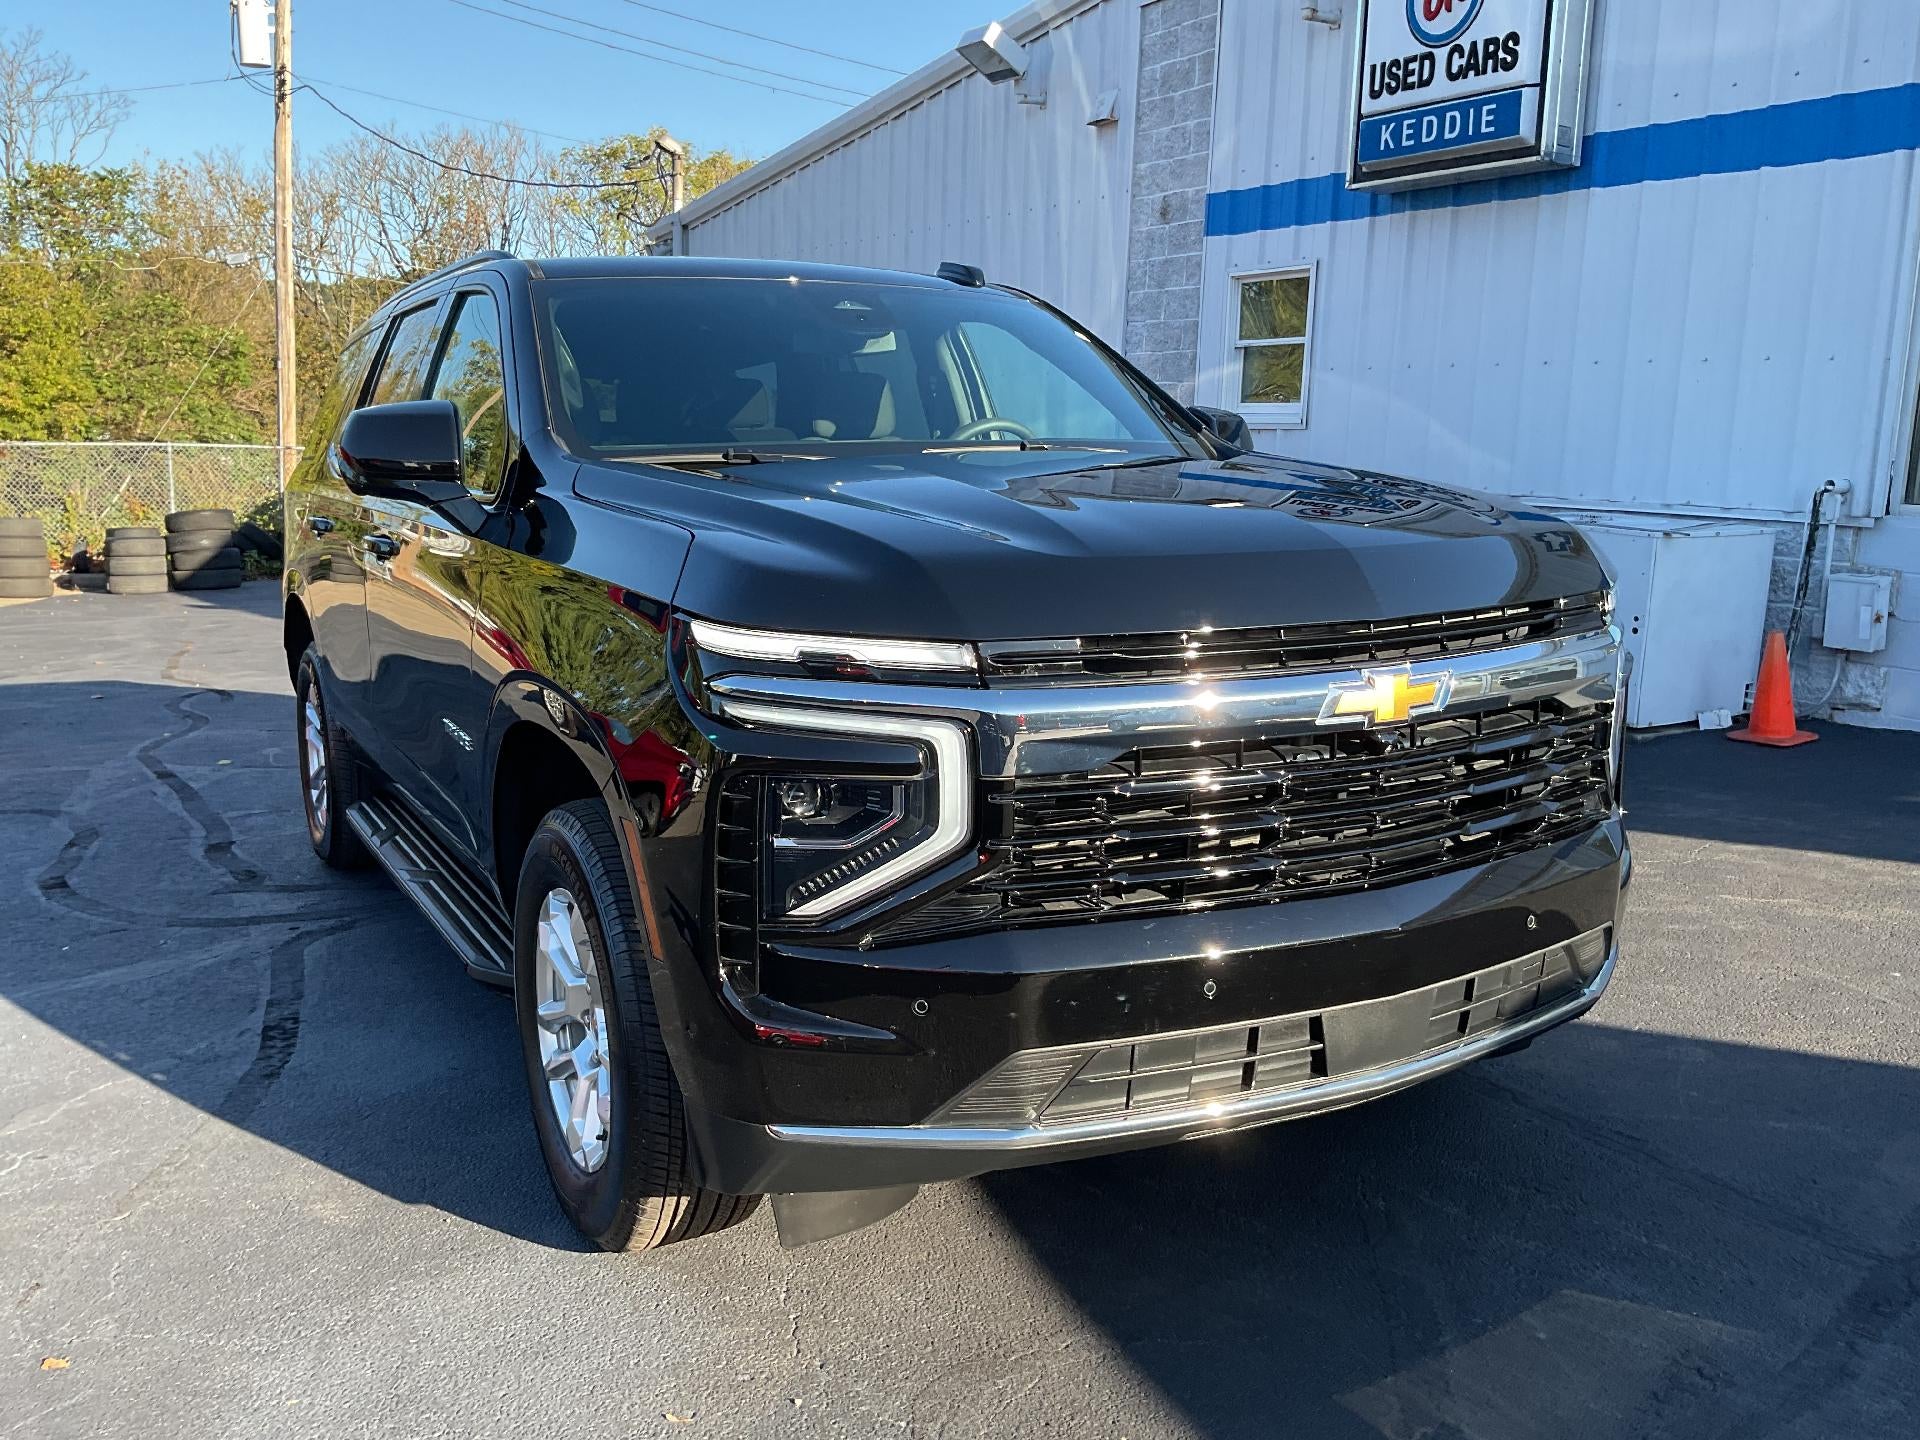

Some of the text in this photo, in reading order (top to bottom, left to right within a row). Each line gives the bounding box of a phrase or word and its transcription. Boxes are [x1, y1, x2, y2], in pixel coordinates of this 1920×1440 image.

[1369, 31, 1520, 100] USED CARS
[1380, 104, 1497, 150] KEDDIE
